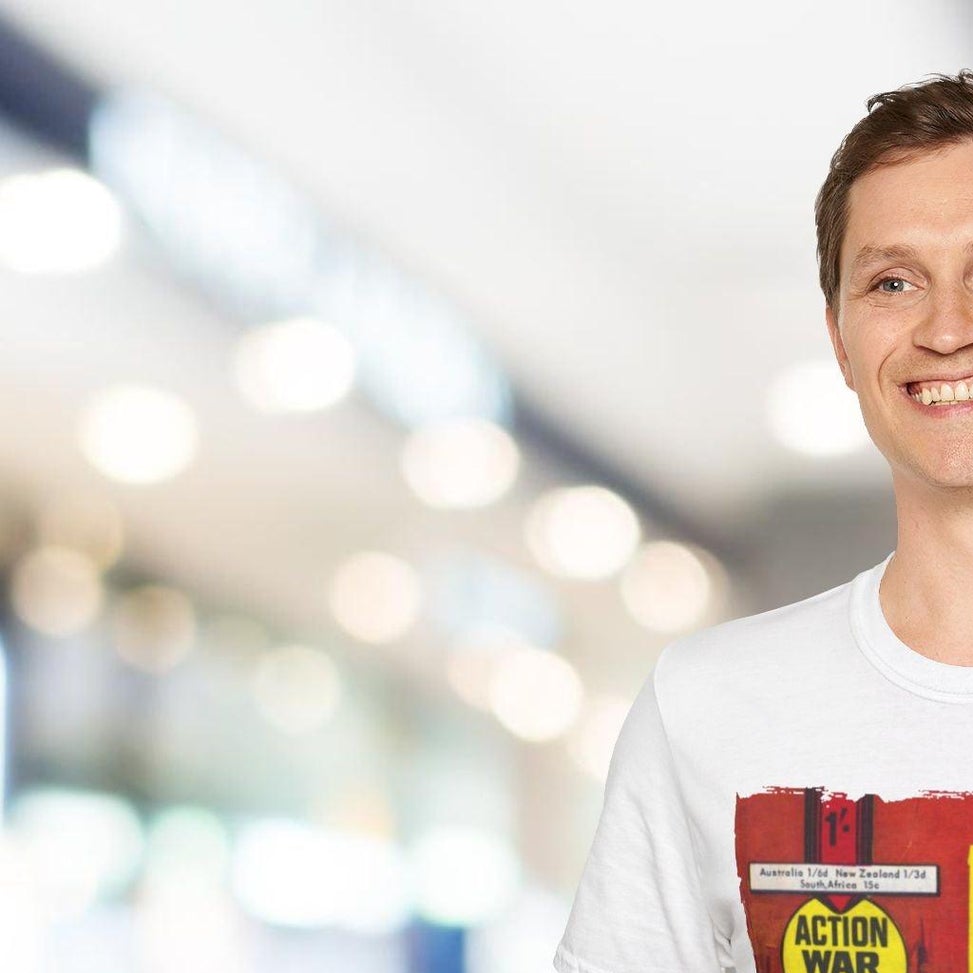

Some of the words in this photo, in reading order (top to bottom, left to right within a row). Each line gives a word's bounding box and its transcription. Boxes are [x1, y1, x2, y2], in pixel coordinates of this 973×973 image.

[760, 868, 803, 877] Australia
[807, 867, 828, 877] 1/6d
[835, 868, 856, 878] New
[859, 868, 900, 879] Zealand
[903, 868, 926, 879] 1/3d
[828, 879, 857, 890] Africa
[864, 881, 880, 890] 15c
[795, 914, 888, 948] ACTION
